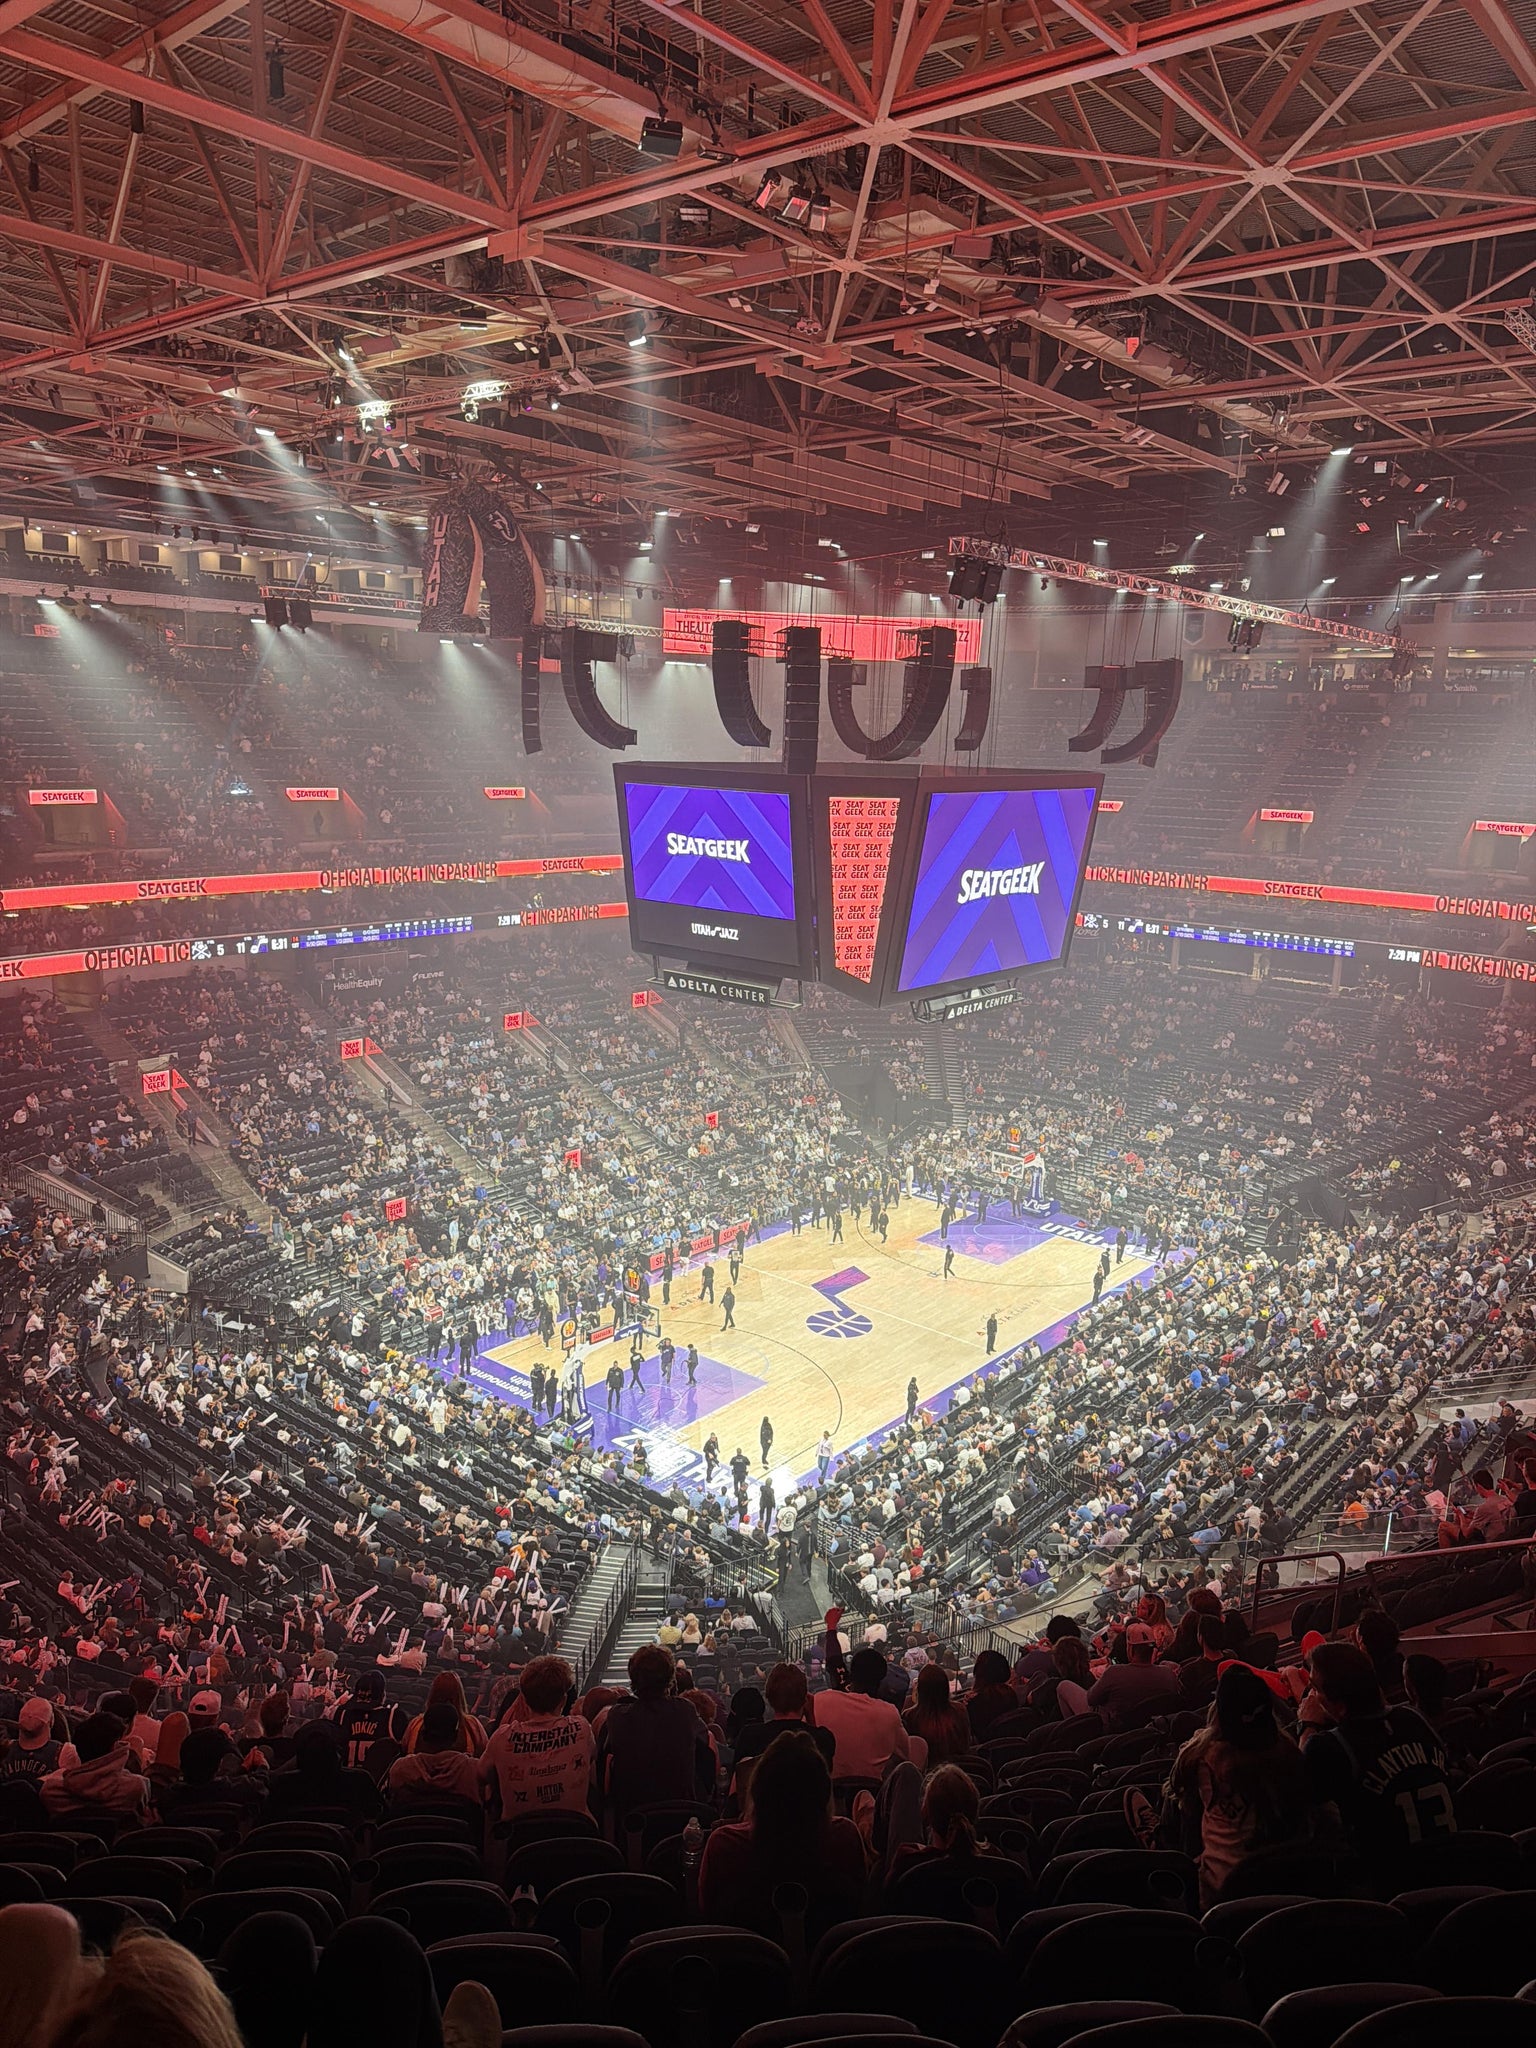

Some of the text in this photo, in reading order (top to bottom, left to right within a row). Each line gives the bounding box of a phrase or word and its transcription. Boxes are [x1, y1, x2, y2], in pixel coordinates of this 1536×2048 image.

[424, 514, 449, 607] UTAH
[42, 792, 85, 802] SEATGEEK
[296, 790, 329, 798] SEATGEEK
[492, 789, 518, 797] SEATGEEK
[845, 808, 864, 816] GEEK
[867, 808, 887, 816] GEEK
[869, 801, 887, 809] SEAT
[1270, 811, 1304, 820] SEATGEEK
[833, 822, 851, 830] SEAT
[856, 822, 873, 830] SEAT
[1487, 823, 1525, 834] SEATGEEK
[667, 832, 751, 864] SEATGEEK
[843, 843, 860, 851] SEAT
[542, 858, 585, 871] SEATGEEK
[320, 861, 497, 887] OFFICIAL TICKETING PARTNER
[957, 861, 1046, 904] SEATGEEK
[1088, 866, 1209, 890] TICKETING PARTNER
[138, 879, 207, 898] SEATGEEK
[1264, 882, 1323, 899] SEATGEEK
[557, 904, 600, 923] PARTNER
[1436, 896, 1504, 917] OFFICIAL
[691, 922, 740, 941] UTAH JAZZ
[858, 925, 875, 933] SEAT
[216, 943, 225, 956] 5
[236, 941, 246, 954] 11
[844, 952, 862, 960] GEEK
[85, 944, 160, 970] OFFICIAL
[333, 978, 384, 991] HealthEquity
[679, 978, 765, 1003] DELTA CENTER
[956, 994, 1014, 1016] DELTA CENTER
[147, 1081, 166, 1090] GEEK
[148, 1074, 165, 1082] SEAT
[1040, 1222, 1104, 1245] UTAH
[508, 1722, 582, 1743] INTERSTATE
[513, 1733, 578, 1753] COMPANY
[1361, 1742, 1429, 1795] CLAYTON
[1394, 1781, 1458, 1844] 13
